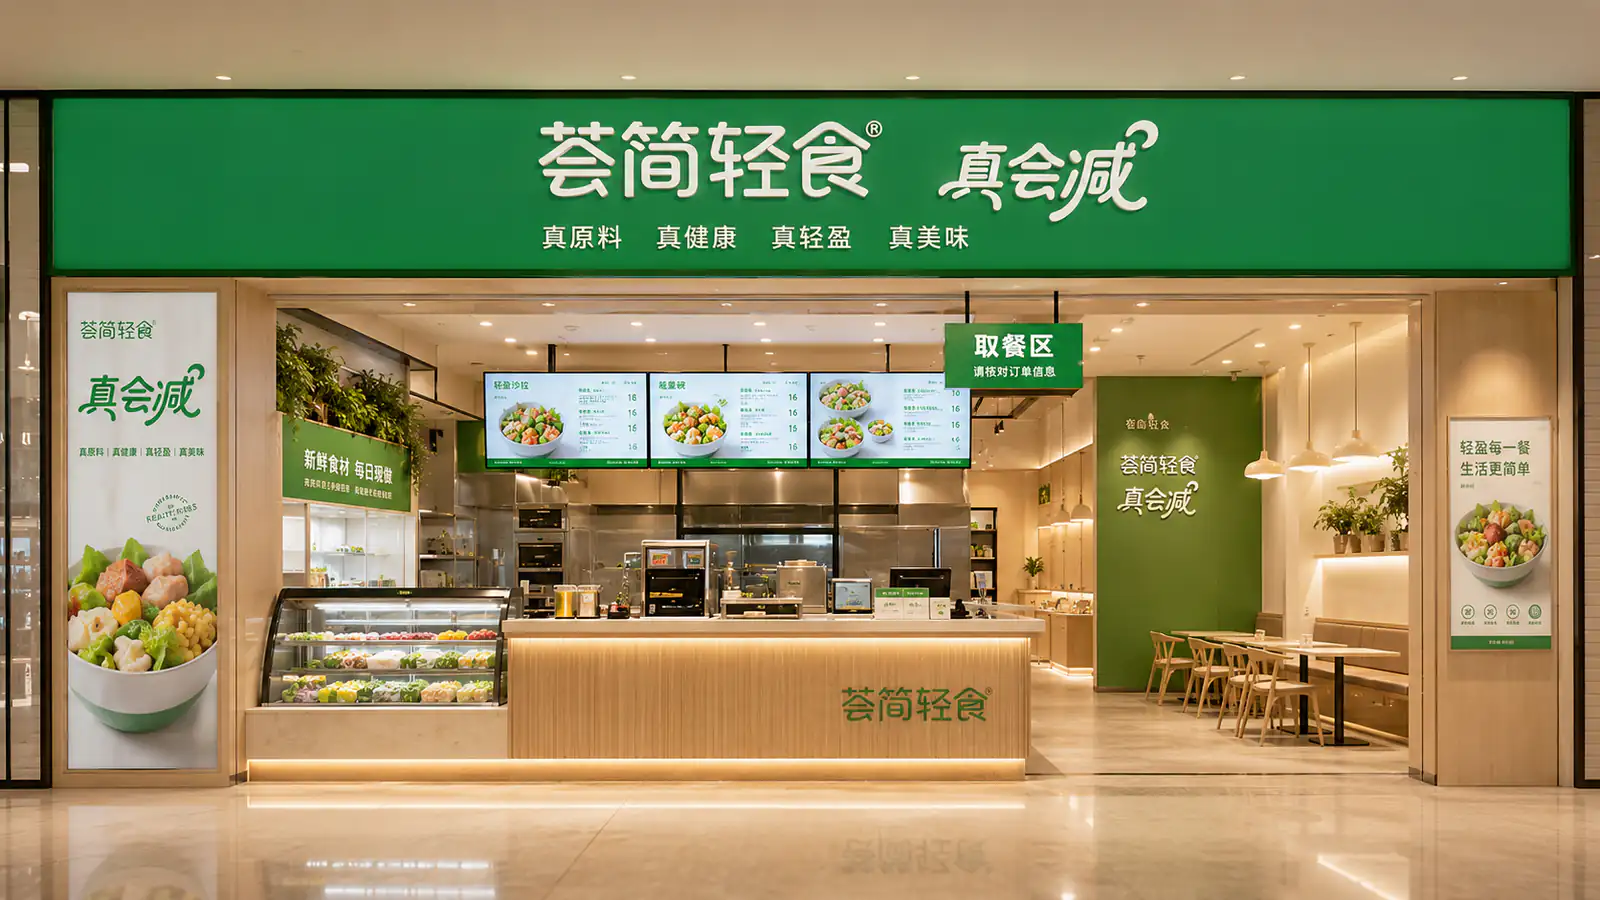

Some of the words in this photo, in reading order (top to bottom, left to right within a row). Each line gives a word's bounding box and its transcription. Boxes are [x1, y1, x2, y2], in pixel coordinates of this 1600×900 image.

[938, 120, 1159, 222] 真会减
[542, 225, 622, 250] 真原料
[656, 225, 737, 250] 真健康
[771, 225, 852, 250] 真轻盈
[889, 225, 970, 250] 真美味
[974, 333, 1054, 359] 取餐区
[973, 365, 1056, 378] 请核对订单信息
[78, 363, 206, 426] 真会减
[788, 393, 798, 401] 16
[788, 409, 798, 417] 16
[951, 405, 961, 413] 16
[1460, 440, 1531, 456] 轻盈每一餐
[304, 448, 350, 477] 新鲜食材
[1460, 461, 1531, 477] 生活更简单
[1117, 481, 1199, 519] 真会减
